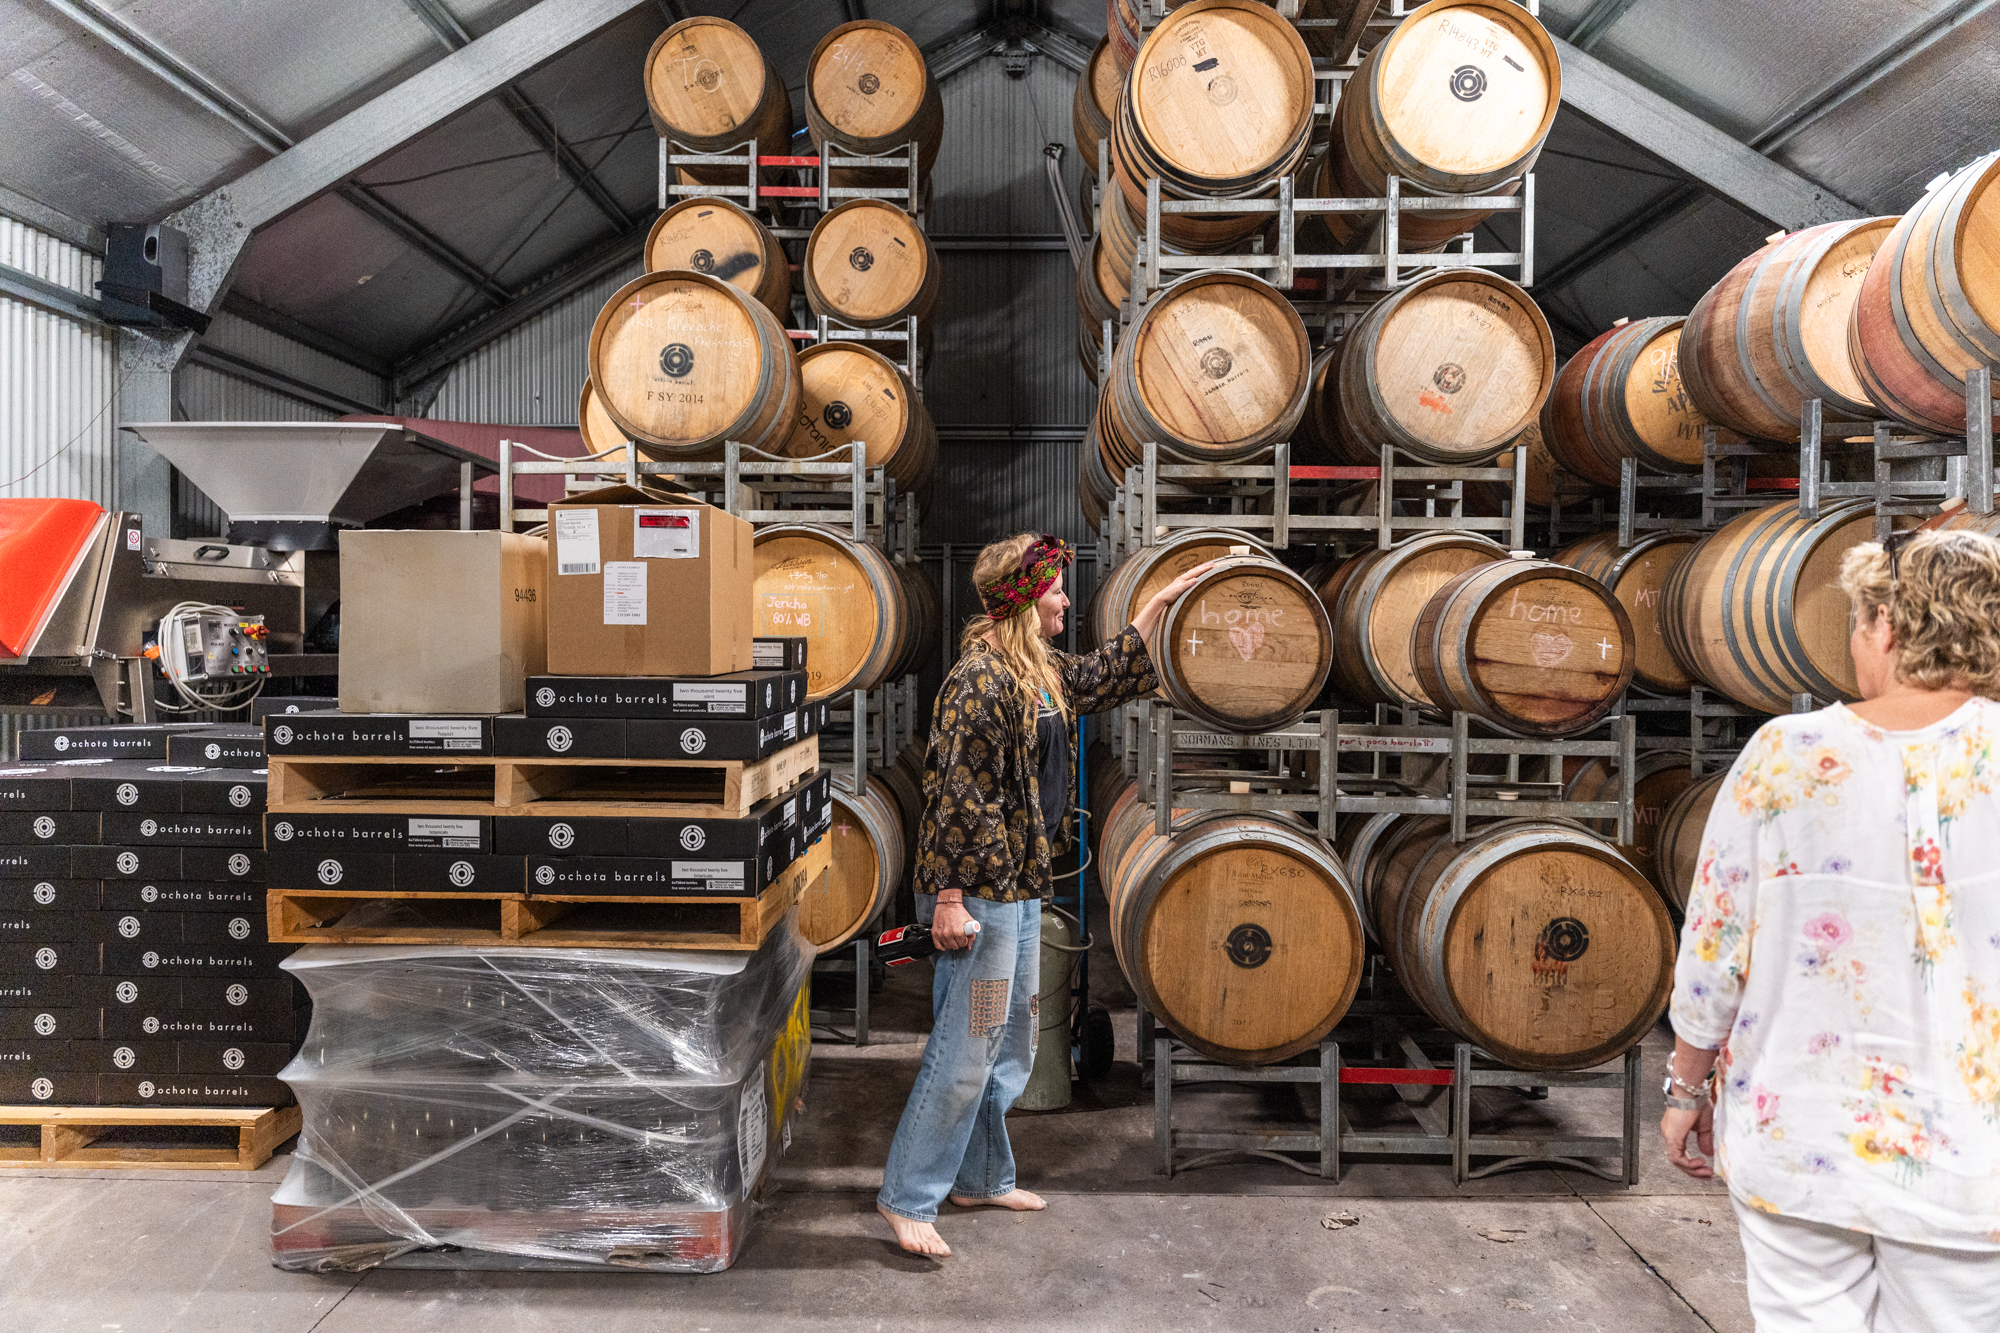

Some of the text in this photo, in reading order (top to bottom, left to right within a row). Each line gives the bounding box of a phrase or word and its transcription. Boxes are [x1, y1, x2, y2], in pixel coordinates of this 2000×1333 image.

[667, 316, 723, 332] Grenache
[647, 390, 704, 404] F SY 2014
[514, 588, 537, 602] 94436
[766, 596, 808, 610] Jericho
[1510, 588, 1582, 625] home
[772, 612, 812, 627] 60% WB
[1201, 600, 1286, 628] home
[559, 692, 667, 704] ochota barrels
[296, 730, 404, 742] ochota barrels
[1180, 734, 1312, 749] NORMANS WINES LTD
[71, 738, 152, 748] ochota barrels
[1366, 740, 1388, 748] poco
[222, 748, 261, 758] ochota
[160, 824, 252, 835] ochota barrels
[297, 826, 403, 839] ochota barrels
[558, 870, 666, 882] ochota barrels
[1260, 864, 1306, 878] RX680
[160, 890, 252, 901] ochota barrels
[1560, 885, 1603, 898] RX682
[162, 956, 253, 966] ochota barrels
[162, 1021, 253, 1032] ochota barrels
[158, 1085, 249, 1096] ochota barrels
